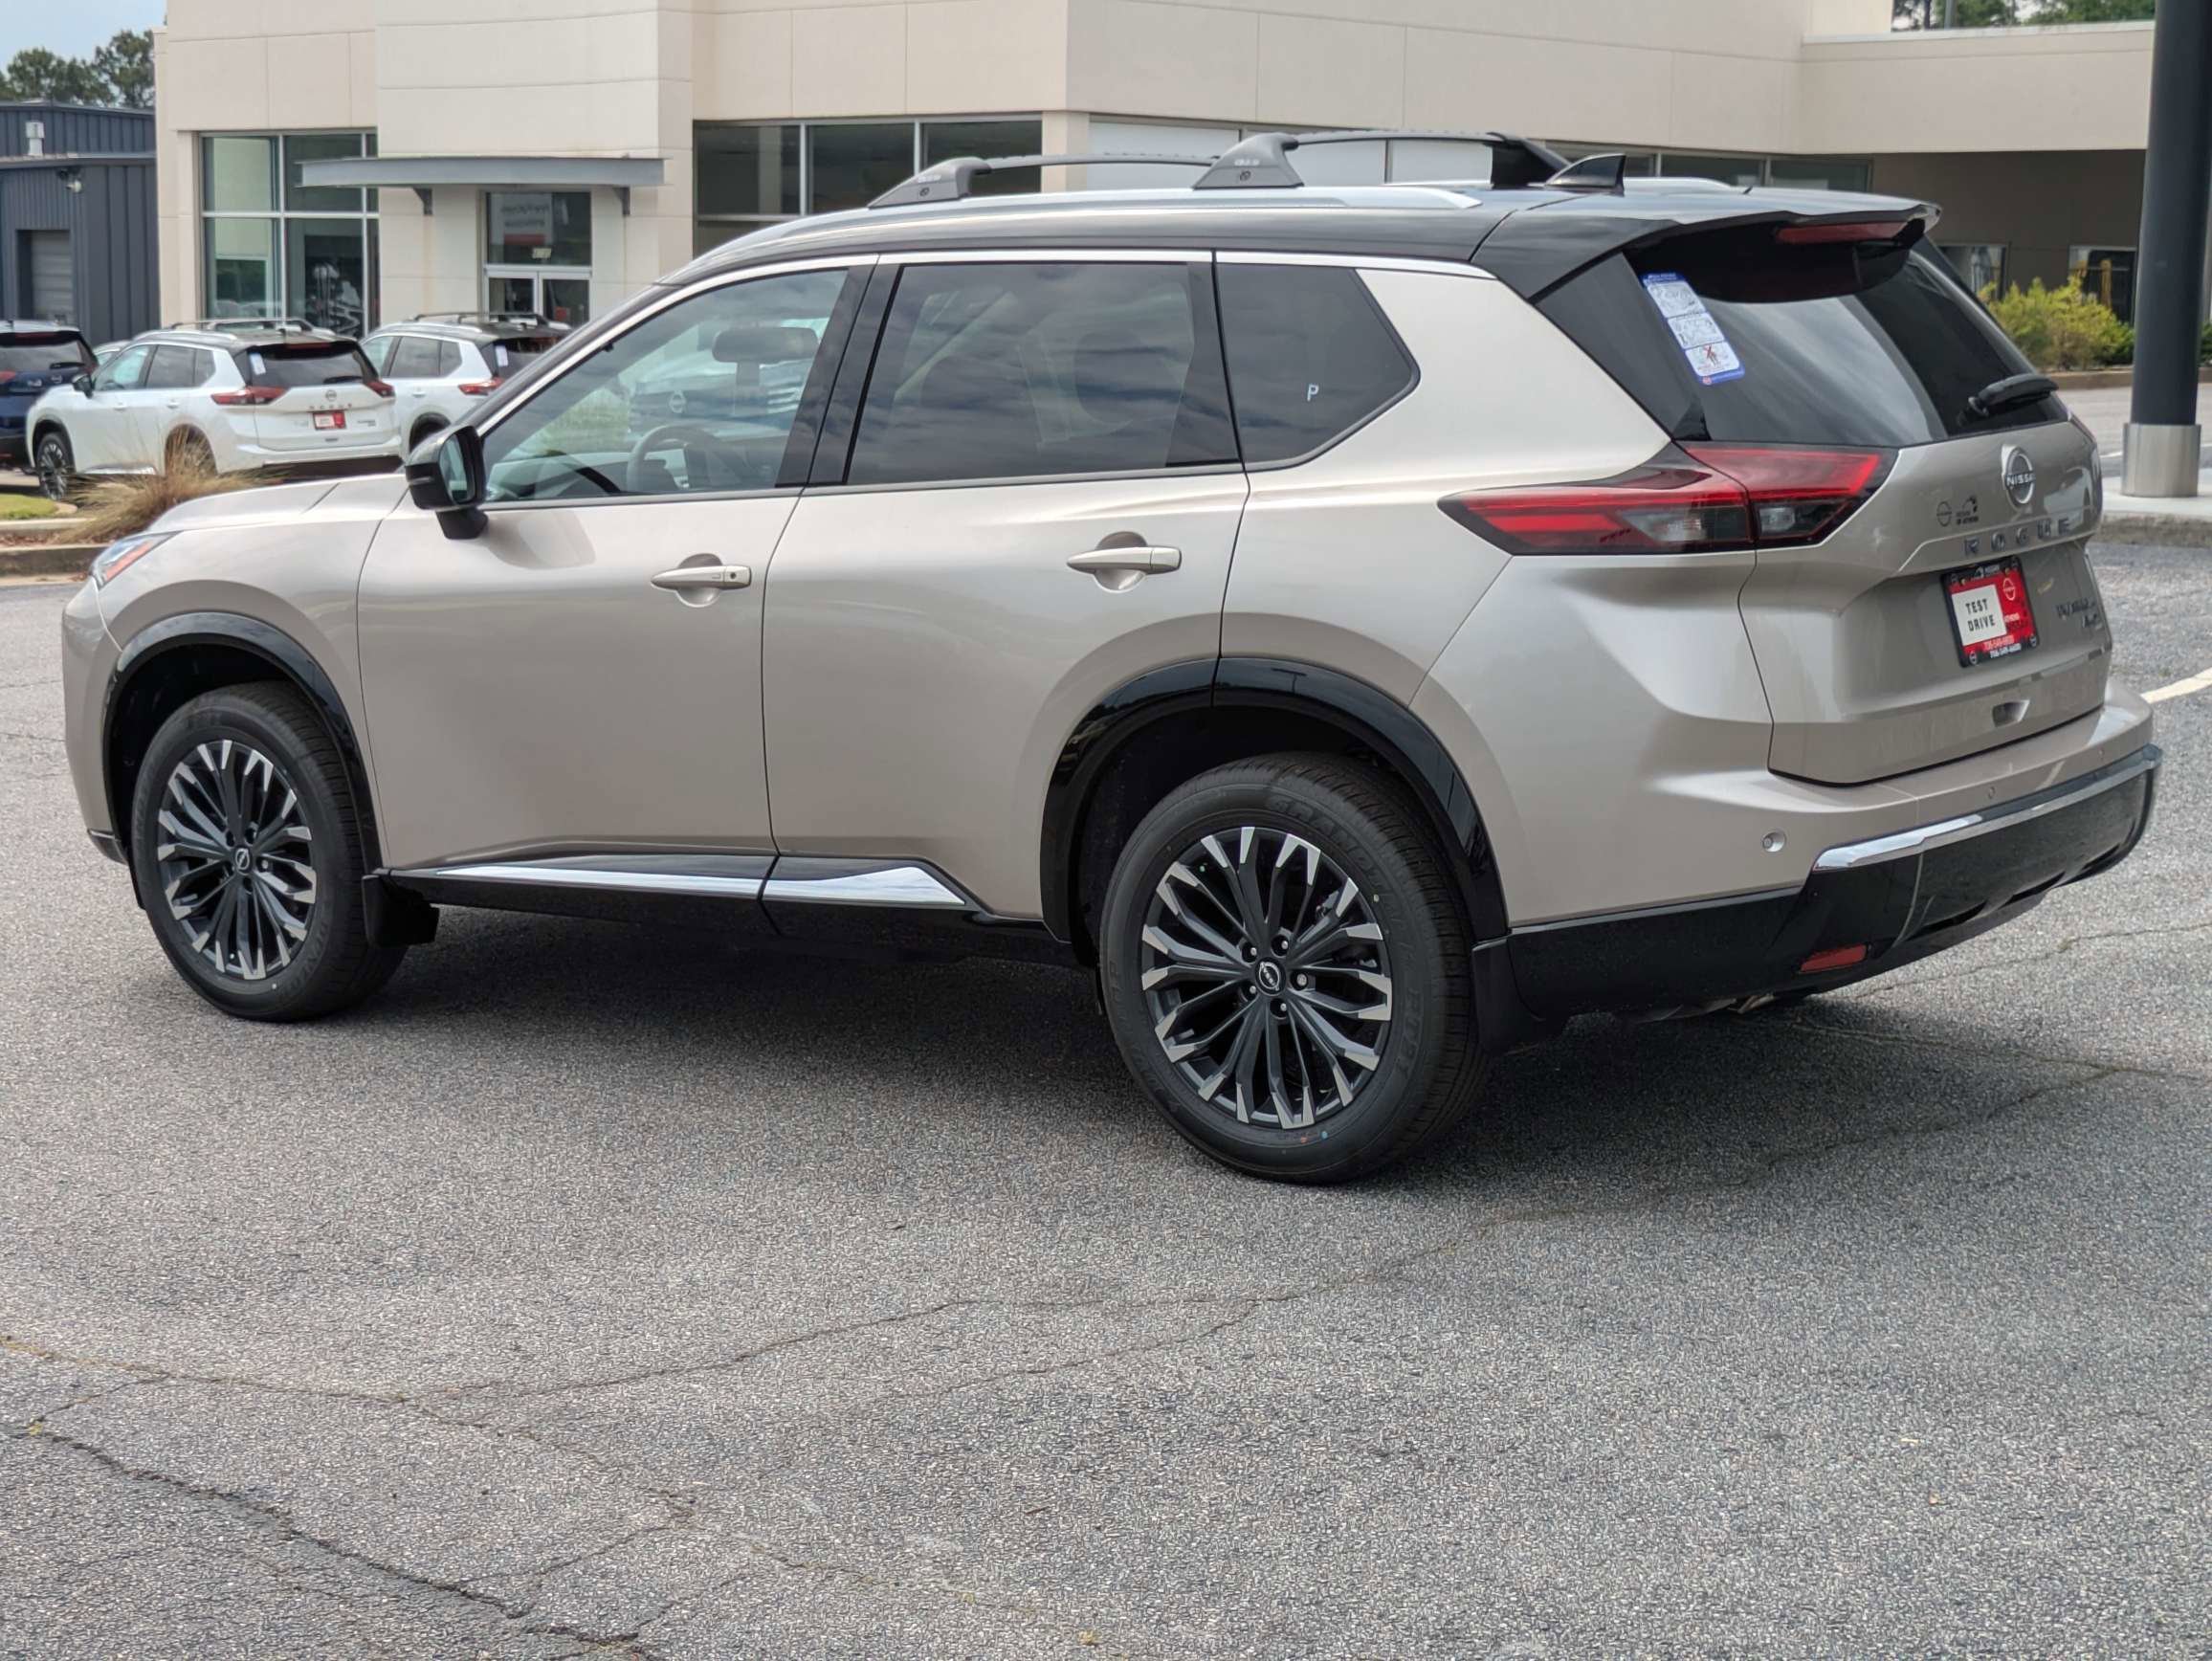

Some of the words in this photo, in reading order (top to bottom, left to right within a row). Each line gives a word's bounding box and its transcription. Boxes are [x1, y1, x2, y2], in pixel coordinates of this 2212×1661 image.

[1307, 384, 1319, 402] P
[1965, 598, 1988, 615] TEST
[1968, 614, 1996, 631] DRIVE
